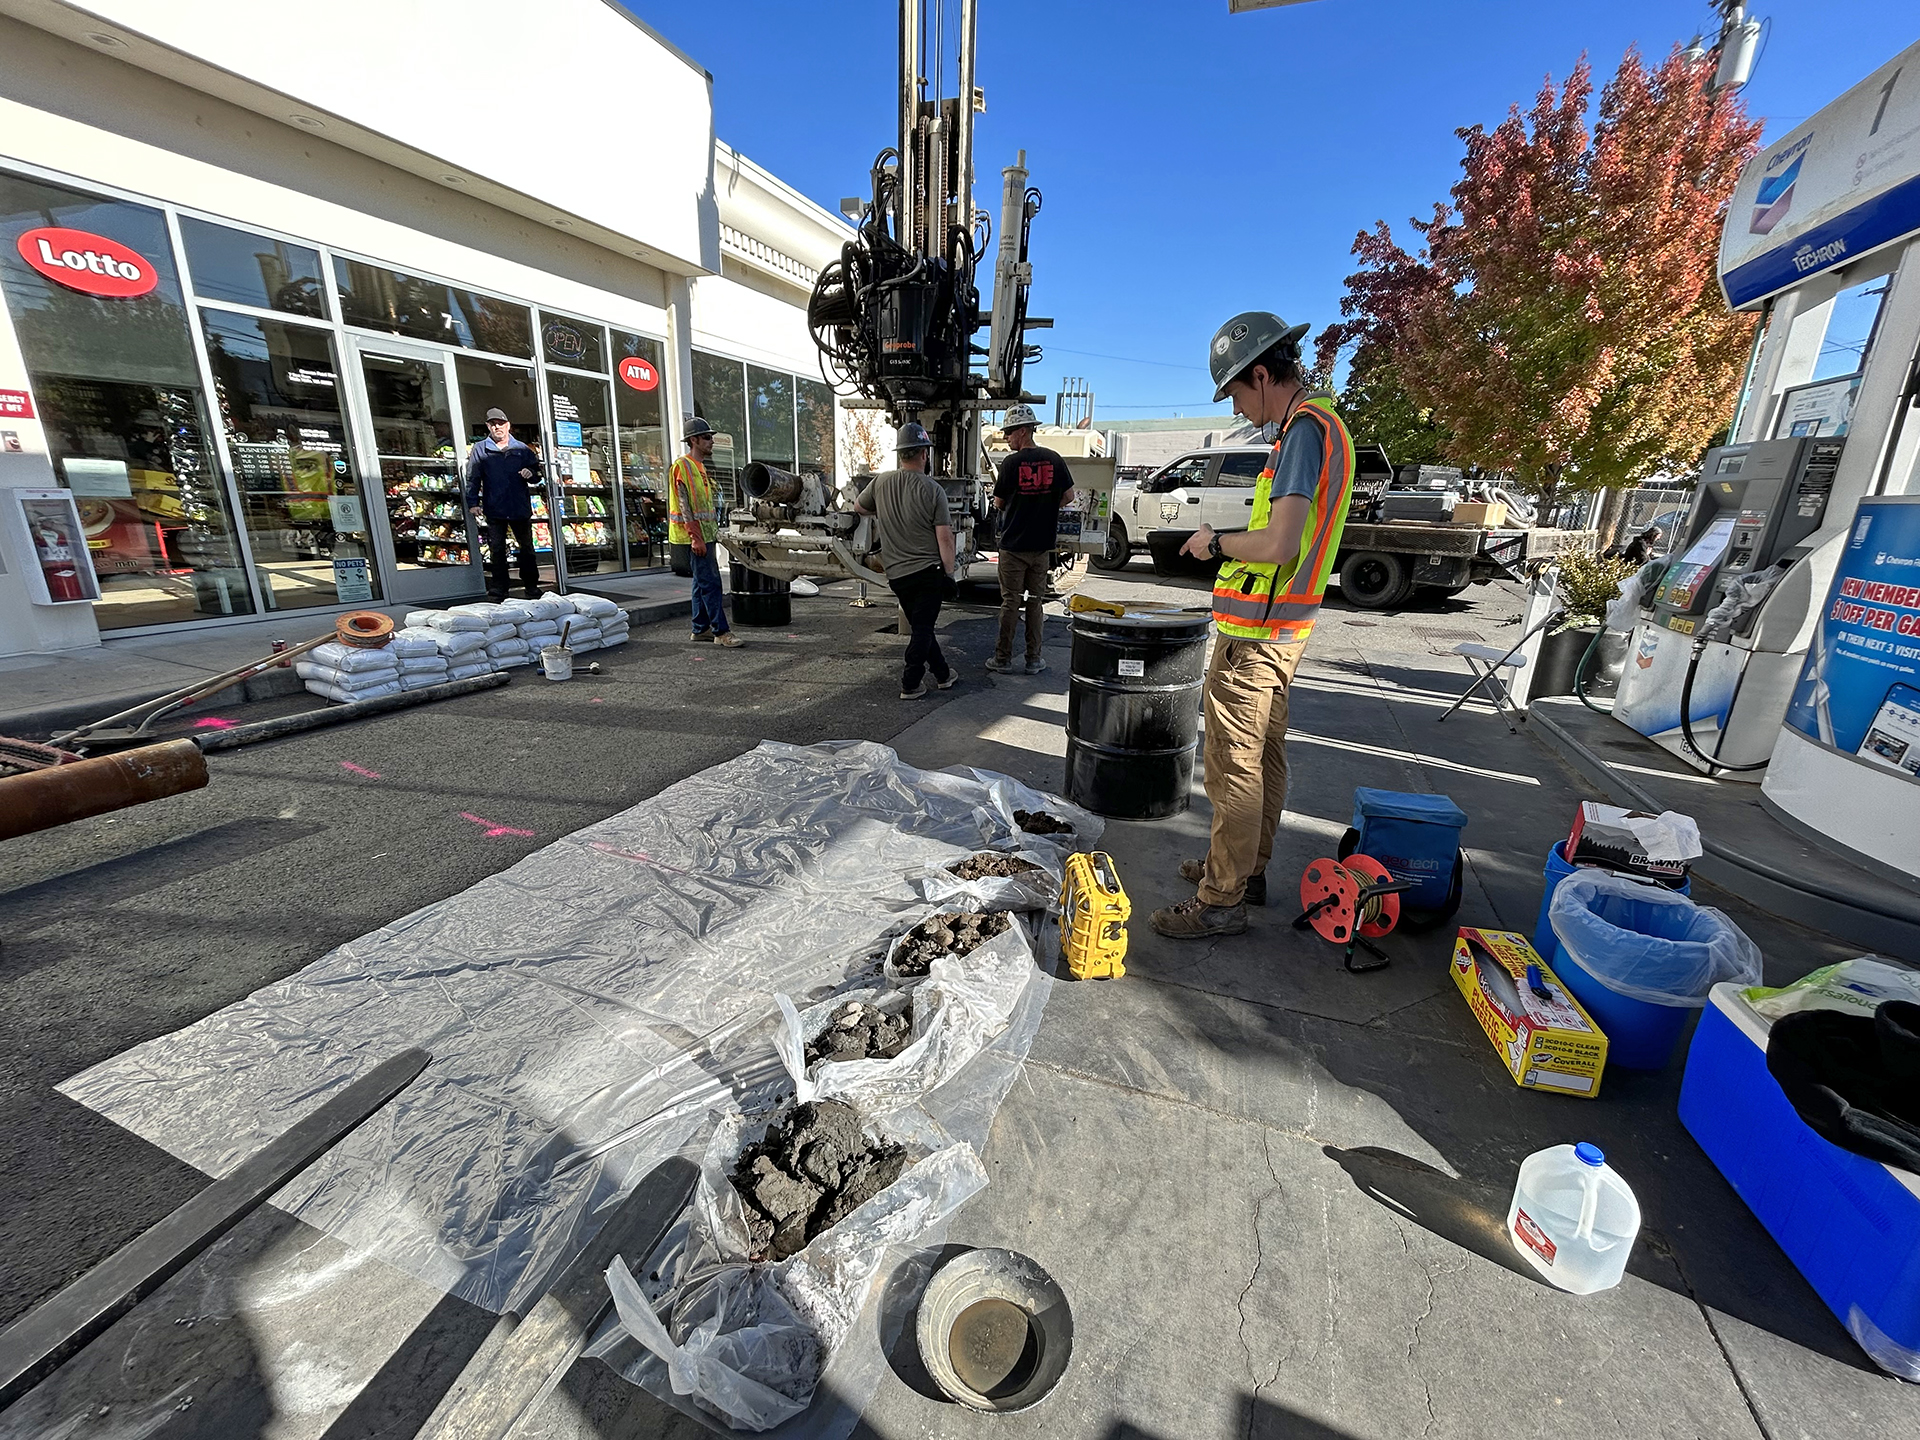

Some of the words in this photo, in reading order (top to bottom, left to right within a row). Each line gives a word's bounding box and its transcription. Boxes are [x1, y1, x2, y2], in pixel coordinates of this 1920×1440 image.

[1867, 66, 1903, 137] 1
[1766, 131, 1815, 172] Chevron
[37, 238, 142, 282] Lotto
[1791, 238, 1847, 273] TECHRON
[546, 331, 583, 351] OPEN
[626, 366, 651, 382] ATM
[1886, 555, 1914, 567] Chevron
[1839, 577, 1865, 600] NEW
[1841, 603, 1867, 625] OFF
[1862, 607, 1897, 633] PER
[1837, 631, 1848, 641] ON
[1846, 633, 1866, 647] THEIR
[1865, 637, 1887, 652] NEXT
[1886, 643, 1895, 654] 3
[1886, 663, 1900, 671] every
[1380, 854, 1439, 870] geotech
[1810, 986, 1878, 1010] rsaTouc
[1472, 986, 1500, 1034] PLASTIC
[1471, 997, 1504, 1055] SHEETING
[1574, 1049, 1599, 1057] BLACK
[1575, 1042, 1600, 1051] CLEAR
[1553, 1056, 1596, 1067] COVERALL
